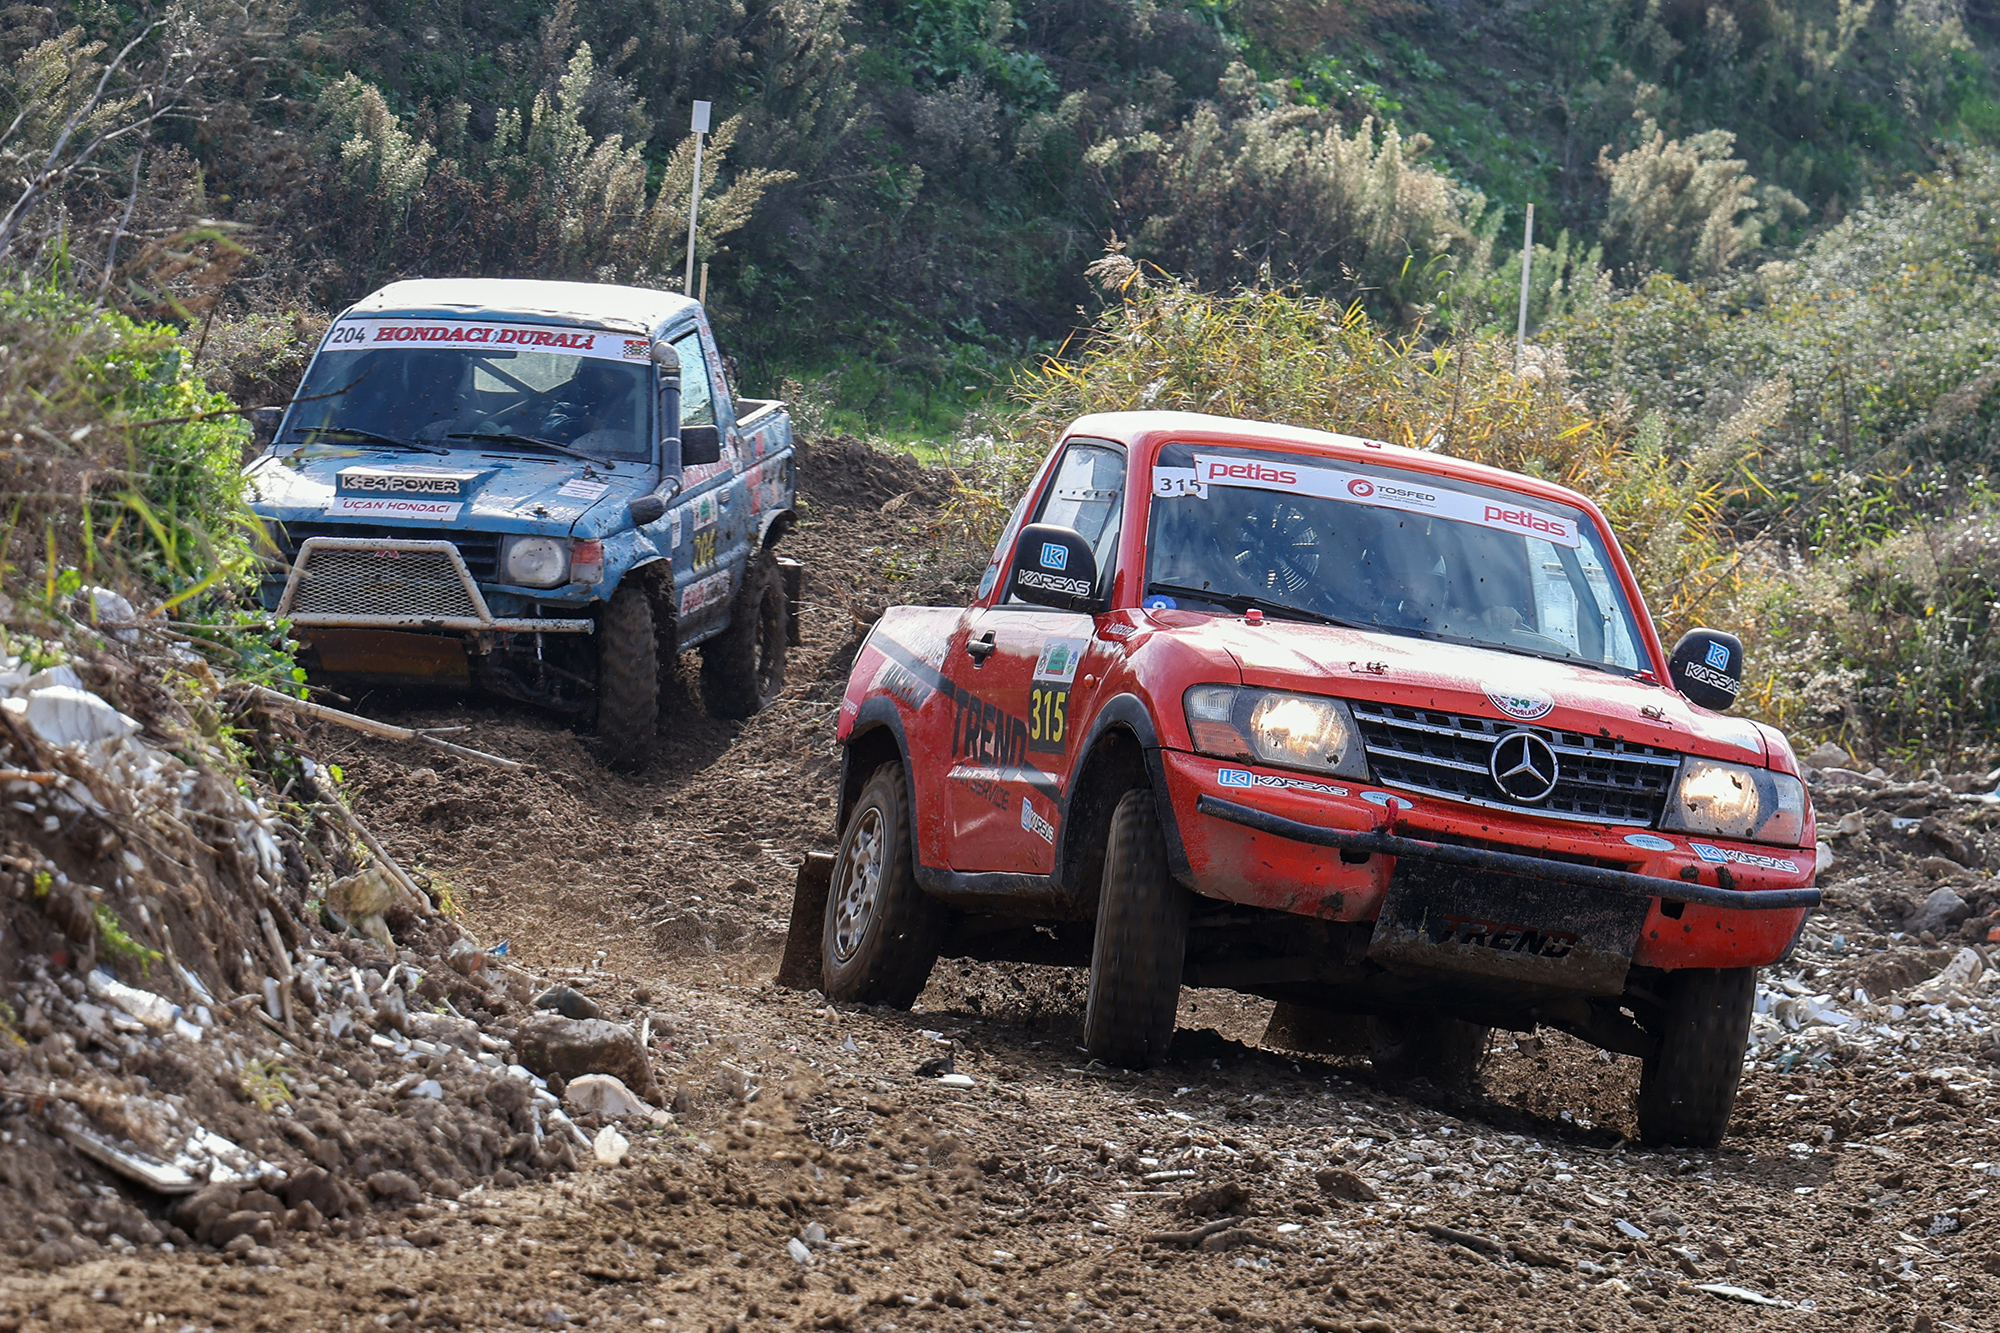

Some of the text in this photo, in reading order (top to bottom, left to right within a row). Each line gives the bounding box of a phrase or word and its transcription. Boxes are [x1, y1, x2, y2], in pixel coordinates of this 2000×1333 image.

[332, 327, 366, 343] 204
[373, 326, 494, 343] HONDACI
[342, 475, 460, 493] K-24 POWER
[1160, 478, 1202, 493] 315
[1208, 463, 1297, 485] petlas
[1376, 485, 1436, 501] TOSFED
[343, 501, 451, 513] UÇAN HONDACI
[1484, 506, 1566, 536] petlas
[1018, 568, 1091, 597] KARSAS
[1031, 688, 1067, 742] 315
[952, 686, 1029, 776] TREND
[1253, 774, 1349, 797] KARSAS
[1722, 849, 1799, 874] KARSAS
[1437, 913, 1580, 959] TREND
